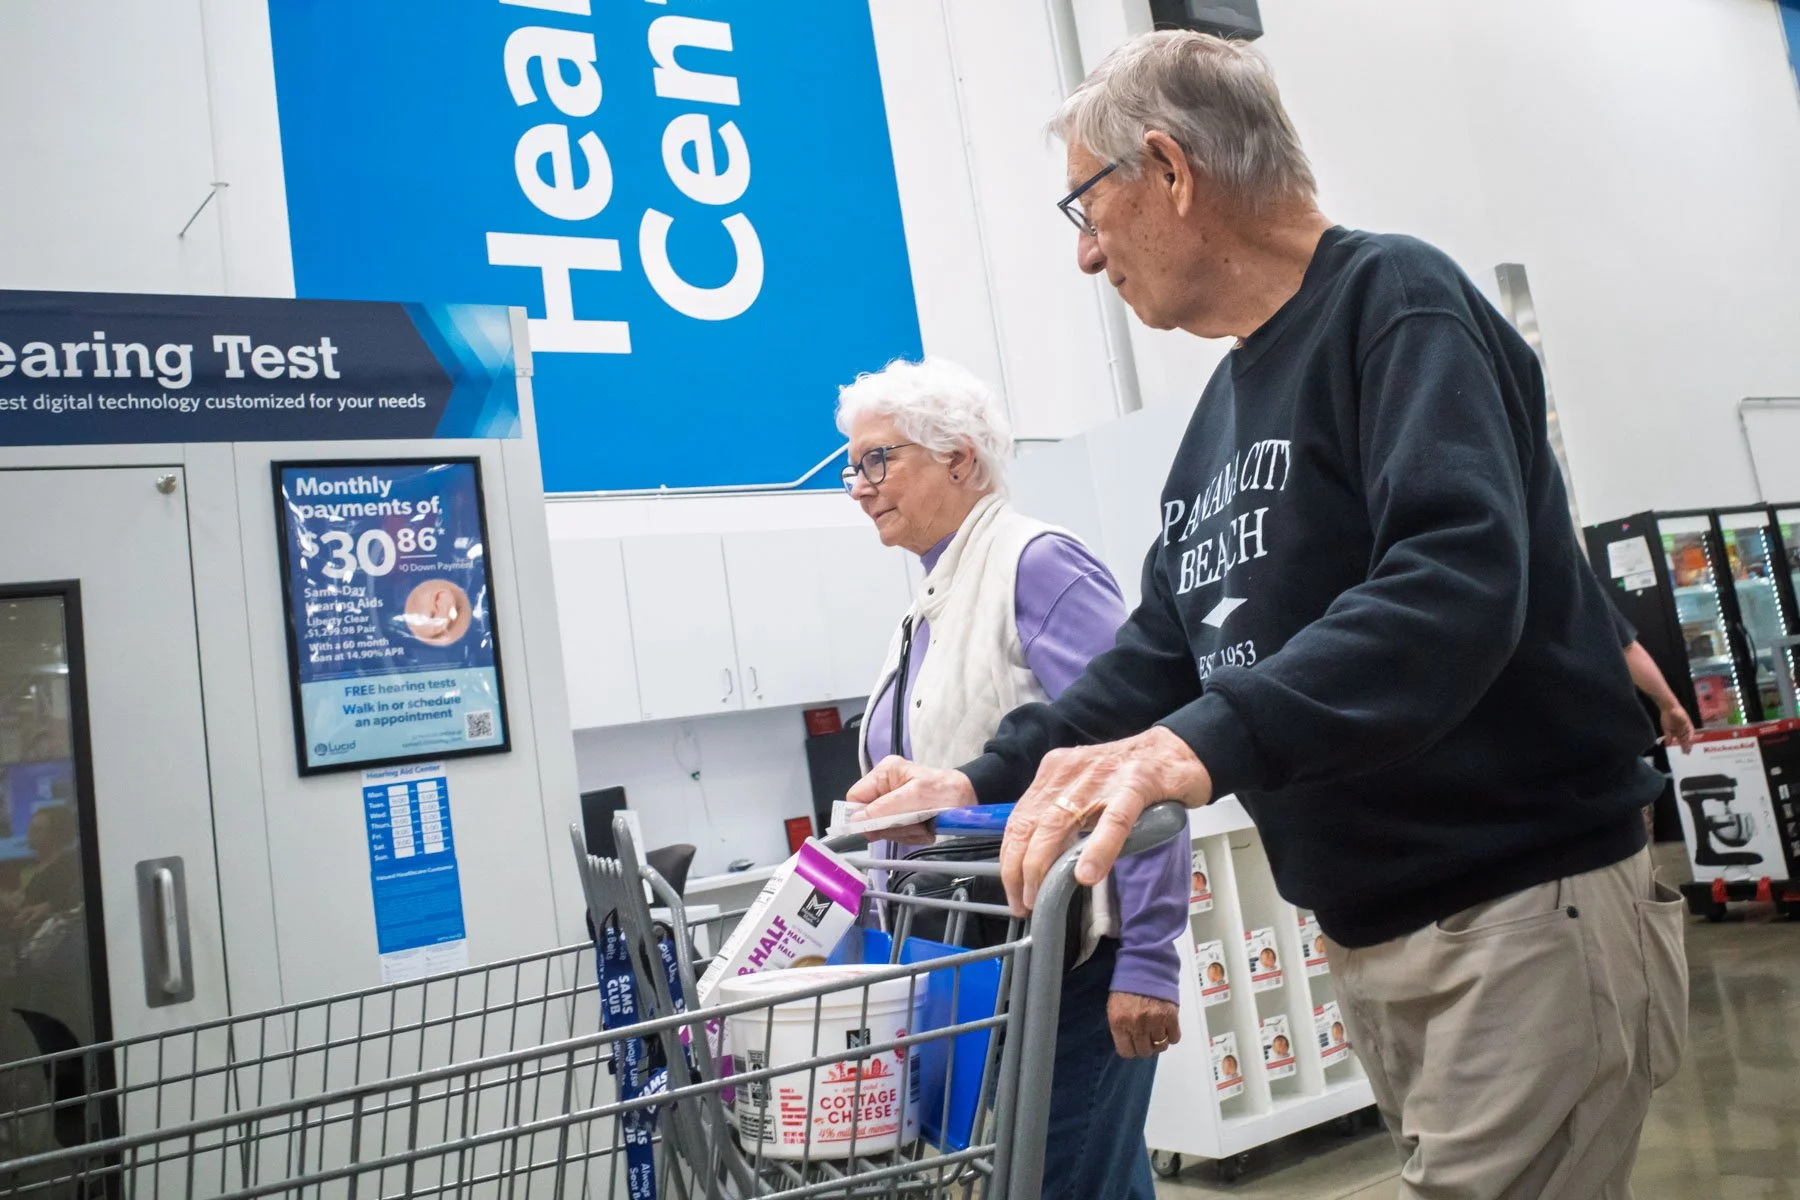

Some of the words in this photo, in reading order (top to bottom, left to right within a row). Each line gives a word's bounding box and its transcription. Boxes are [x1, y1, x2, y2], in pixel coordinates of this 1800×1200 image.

[639, 0, 764, 321] Cen
[486, 0, 632, 354] Hea
[212, 335, 341, 379] Test
[33, 393, 93, 413] digital
[98, 393, 200, 412] technology
[205, 393, 305, 409] customized
[309, 394, 333, 409] for
[337, 397, 374, 412] your
[378, 393, 426, 409] needs
[296, 475, 393, 498] Monthly
[299, 499, 412, 519] payments
[416, 496, 441, 514] of
[410, 563, 436, 572] Down
[304, 585, 366, 598] Same-Day
[357, 597, 384, 608] Aids
[344, 614, 369, 624] Clear
[357, 625, 376, 634] Pair
[357, 638, 389, 648] month
[1220, 639, 1257, 667] 1953
[311, 652, 332, 662] oan
[335, 653, 344, 661] at
[385, 647, 404, 657] APR
[344, 684, 375, 697] FREE
[378, 682, 426, 695] hearing
[428, 678, 457, 689] tests
[342, 702, 374, 715] Walk
[377, 701, 389, 712] in
[391, 700, 405, 710] or
[407, 694, 462, 709] schedule
[355, 717, 370, 728] an
[373, 709, 453, 727] appointment
[748, 915, 788, 967] HALF
[786, 929, 806, 945] HALF
[777, 944, 796, 959] HALF
[607, 979, 621, 1015] CLUB
[618, 975, 634, 1015] SAMS
[820, 1088, 897, 1110] COTTAGE
[828, 1104, 892, 1124] CHEESE
[629, 1168, 638, 1190] Seat
[641, 1163, 650, 1198] Always
